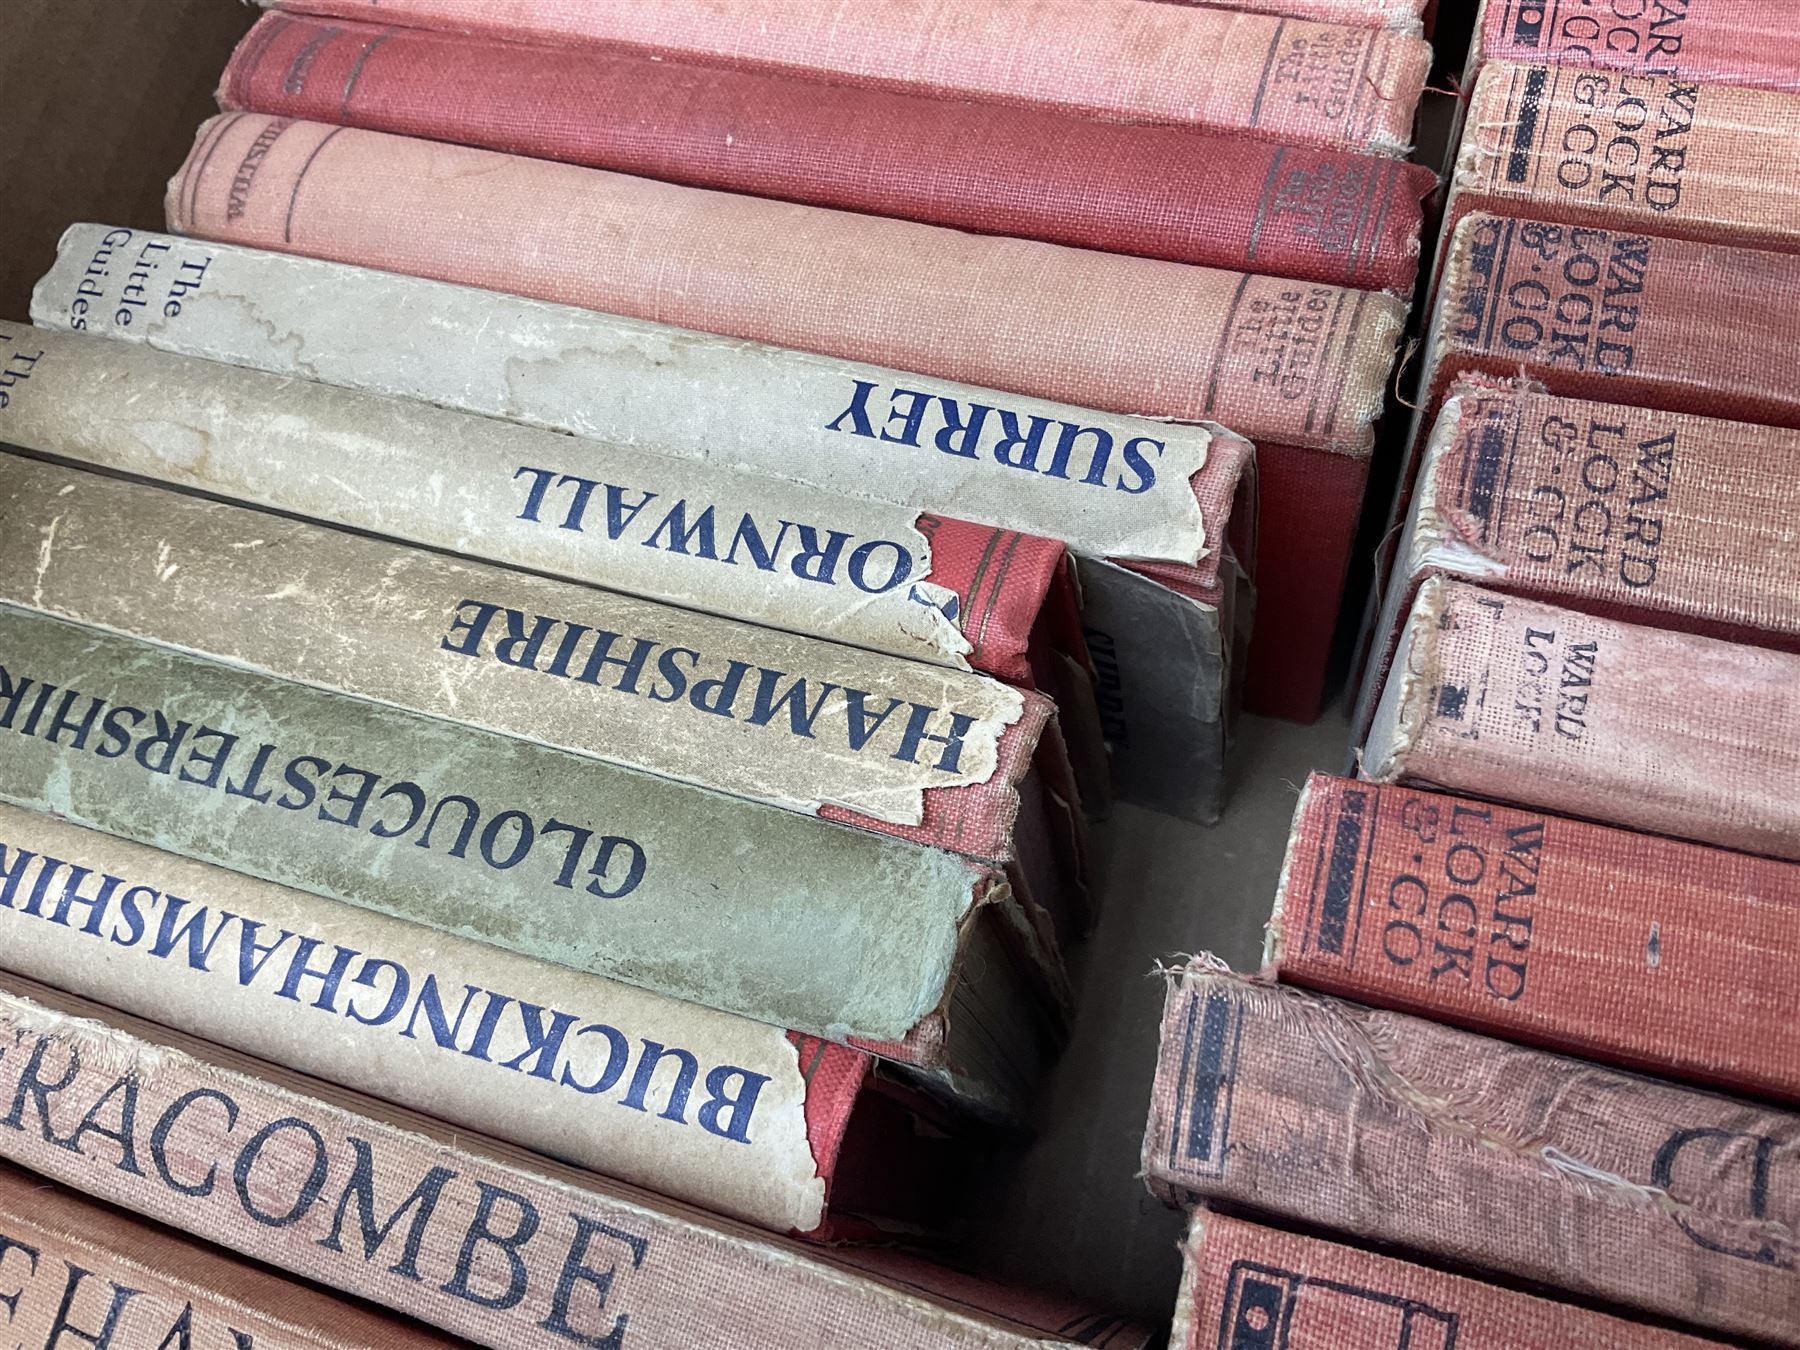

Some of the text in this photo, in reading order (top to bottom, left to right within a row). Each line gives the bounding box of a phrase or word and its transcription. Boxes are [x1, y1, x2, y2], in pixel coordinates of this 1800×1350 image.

[1645, 0, 1688, 77] AR
[226, 118, 297, 223] WILTSHI
[1600, 75, 1655, 202] LOCK
[1646, 80, 1699, 212] WARD
[70, 229, 133, 331] Guides
[114, 240, 172, 327] Little
[162, 256, 213, 318] The
[1232, 299, 1271, 350] The
[1550, 226, 1607, 371] LOCK
[1594, 236, 1652, 378] WARD
[1253, 291, 1301, 386] Little
[1280, 287, 1332, 401] Guides
[824, 379, 1166, 495] SURREY
[1566, 416, 1626, 578] LOCK
[1619, 427, 1677, 589] WARD
[441, 598, 979, 775] HAMPSHIRE
[1514, 626, 1556, 734] LOK
[1554, 640, 1599, 741] WARD
[1430, 803, 1493, 983] LOCK
[1484, 818, 1546, 1002] WARD
[0, 1027, 649, 1350] RACOMBE
